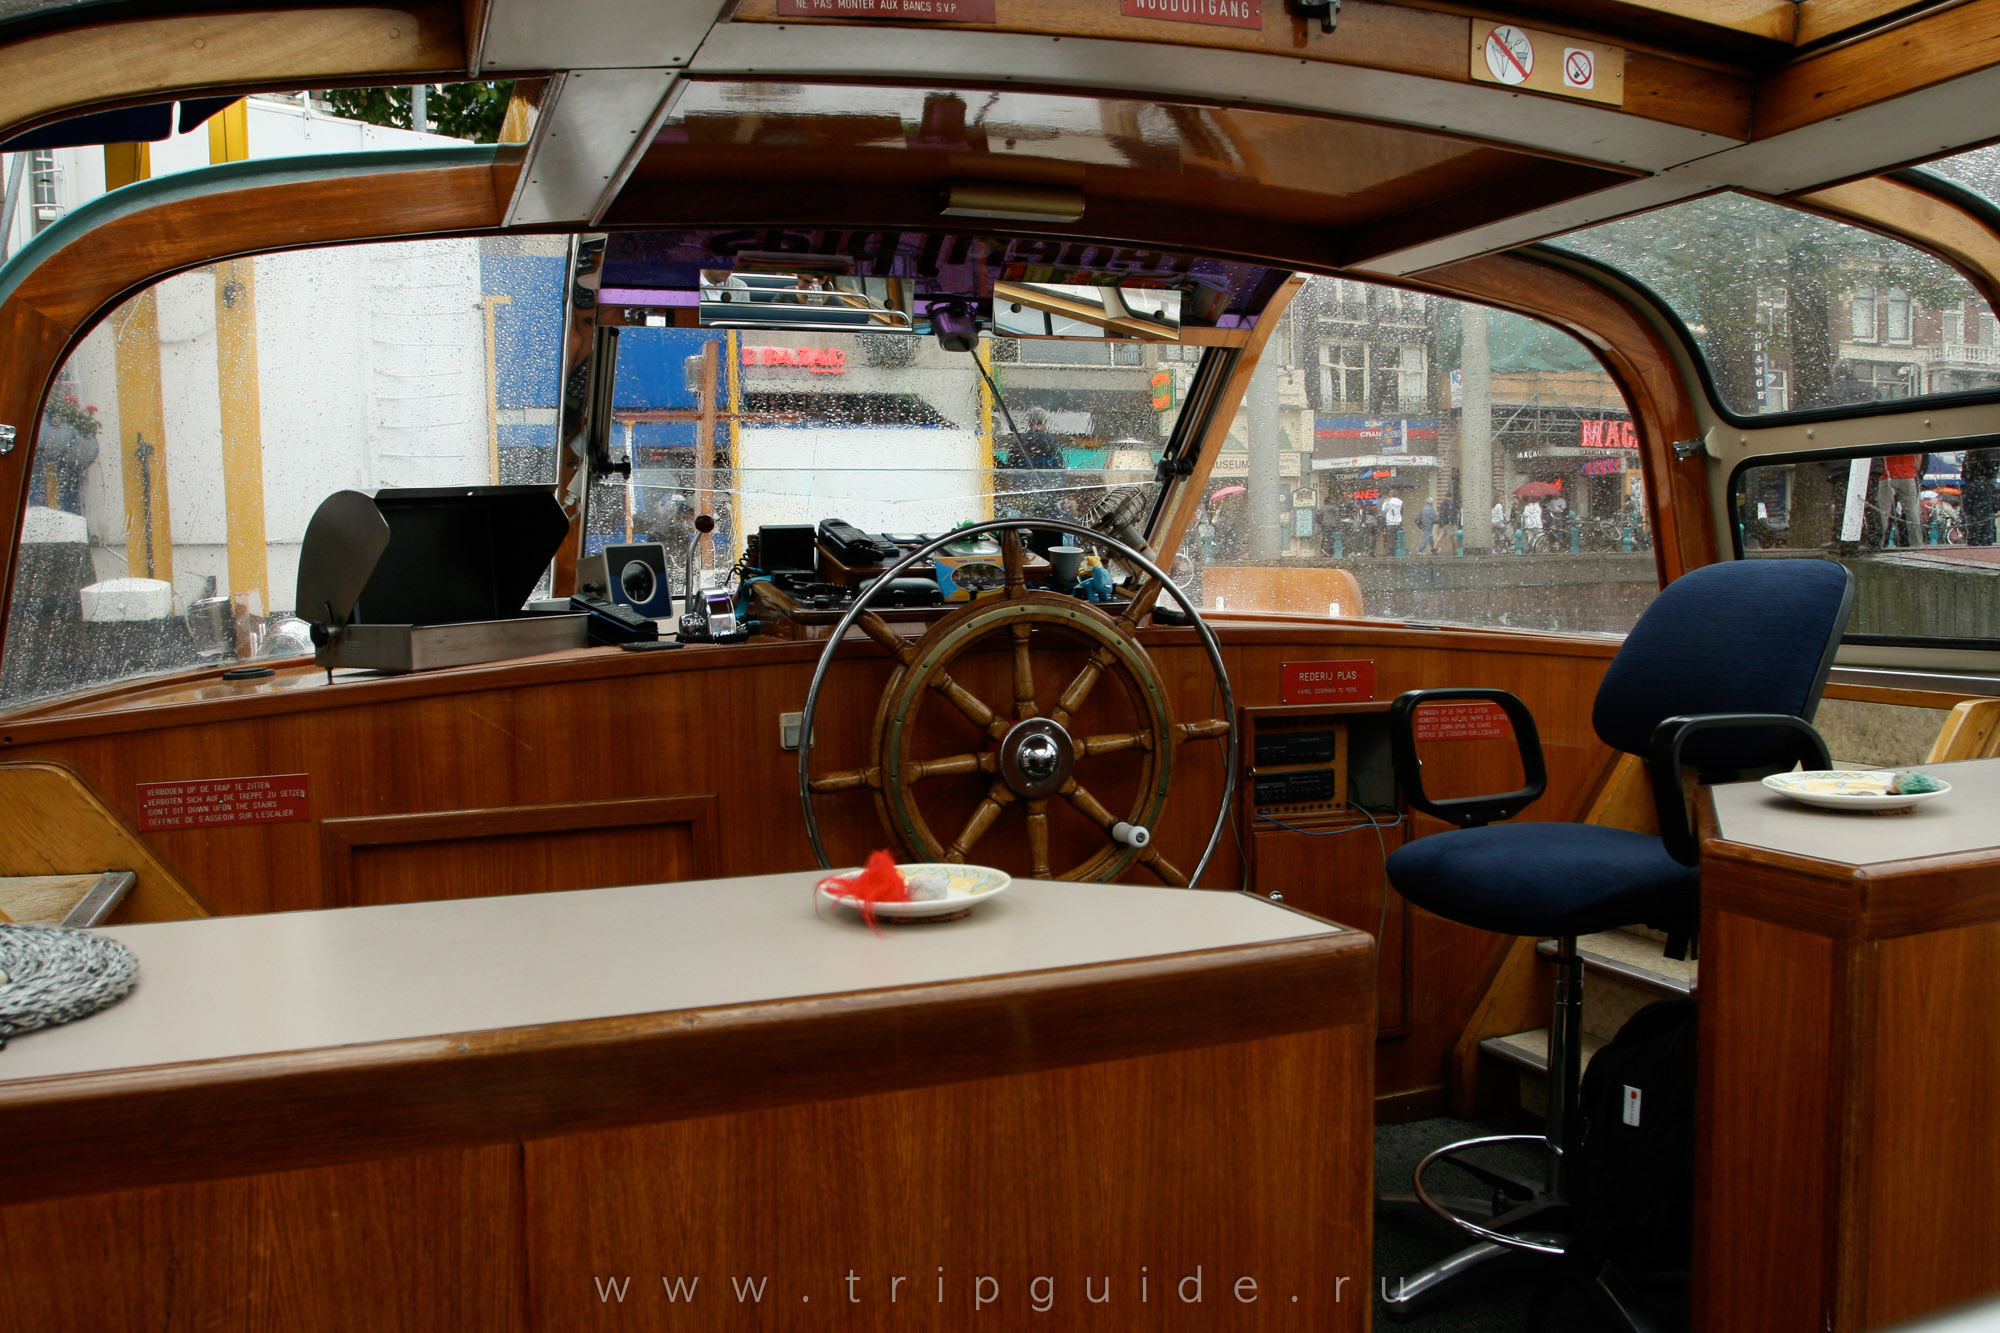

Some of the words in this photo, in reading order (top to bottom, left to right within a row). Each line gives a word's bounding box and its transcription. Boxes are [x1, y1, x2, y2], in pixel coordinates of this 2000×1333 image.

[796, 0, 808, 9] NE
[814, 0, 832, 9] PAS
[838, 0, 875, 10] MONTER
[880, 0, 898, 10] AUX
[903, 0, 932, 12] BANCS
[1755, 331, 1764, 400] CHANGE
[1213, 460, 1249, 470] USEUM
[1299, 672, 1333, 681] REDERIJ
[1338, 671, 1357, 680] PLAS
[146, 787, 183, 796] VERBODEN
[187, 786, 197, 794] OP
[200, 785, 209, 793] DE
[214, 784, 230, 792] TRAP
[247, 782, 270, 790] ZITTEN
[148, 797, 183, 807] VERBOTEN
[186, 796, 202, 804] SICH
[239, 791, 263, 800] TREPPE
[280, 789, 305, 797] SETZEN
[172, 806, 184, 814] SIT
[188, 805, 209, 814] DOWN
[213, 804, 232, 812] UPON
[236, 802, 248, 810] THE
[252, 800, 277, 809] STAIRS
[185, 816, 194, 824] DE
[239, 812, 253, 820] SUR
